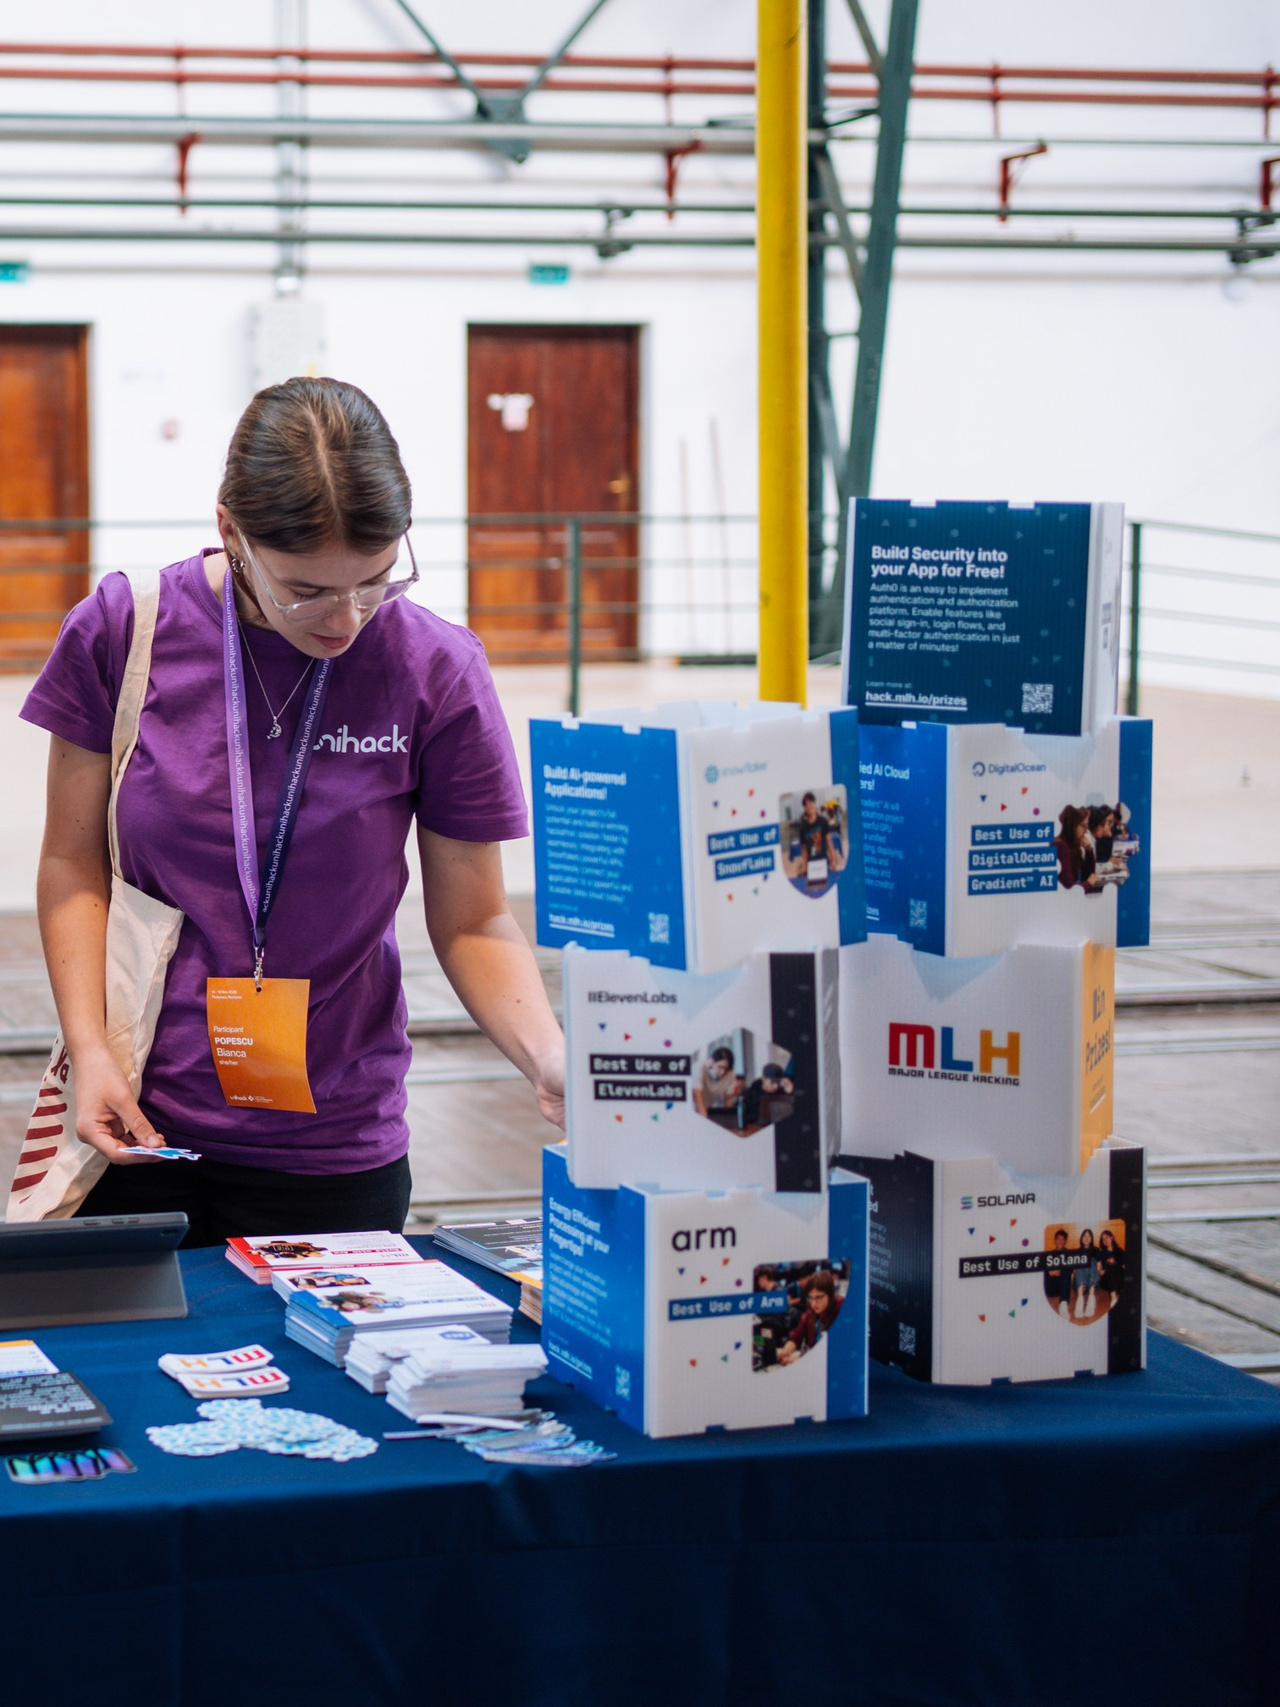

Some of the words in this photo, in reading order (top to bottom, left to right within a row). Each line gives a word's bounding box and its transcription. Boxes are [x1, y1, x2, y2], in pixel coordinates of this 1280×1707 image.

[871, 545, 909, 560] Build
[912, 547, 975, 563] Security
[977, 549, 1008, 562] into
[871, 563, 905, 578] your
[907, 563, 939, 579] App
[941, 564, 963, 578] for
[965, 564, 1005, 579] Free!
[899, 583, 908, 593] is
[909, 585, 921, 594] an
[923, 586, 946, 596] easy
[947, 585, 957, 595] to
[958, 585, 1009, 597] implement
[869, 594, 936, 606] authentication
[936, 596, 955, 606] and
[956, 597, 1019, 608] authorization
[868, 605, 910, 617] platform.
[911, 607, 943, 618] Enable
[945, 608, 984, 619] features
[985, 610, 1002, 620] like
[868, 617, 895, 627] social
[896, 617, 932, 630] sign-in,
[932, 619, 956, 631] login
[957, 620, 985, 631] flows,
[987, 621, 1006, 631] and
[867, 628, 922, 640] multi-factor
[923, 630, 991, 643] authentication
[992, 633, 1001, 642] in
[1002, 634, 1020, 645] just
[875, 641, 905, 651] matter
[907, 642, 918, 651] of
[919, 643, 960, 652] minutes!
[866, 680, 884, 688] Learn
[865, 690, 968, 706] hack.mlh.io/prizes
[543, 765, 567, 780] Build
[873, 763, 883, 776] AI
[884, 765, 910, 780] Cloud
[988, 762, 1046, 775] DigitalOcean
[544, 781, 608, 801] Applications!
[709, 836, 736, 851] Best
[739, 832, 760, 846] Use
[763, 828, 778, 843] of
[974, 829, 1003, 841] Best
[1009, 828, 1031, 840] Use
[1036, 826, 1051, 839] of
[717, 856, 773, 876] Snowflake
[972, 851, 1055, 868] DigitalOcean
[1039, 875, 1054, 888] AI
[213, 1025, 244, 1034] Participant
[214, 1036, 254, 1046] POPESCU
[888, 1022, 1020, 1076] MLH
[216, 1047, 247, 1058] Bianca
[593, 1057, 628, 1072] Best
[634, 1057, 662, 1072] Use
[668, 1057, 687, 1072] of
[888, 1067, 925, 1079] MAJOR
[928, 1070, 969, 1082] LEAGUE
[972, 1074, 1020, 1087] HACKING
[597, 1082, 684, 1098] ElevenLabs
[976, 1193, 1036, 1209] SOLANA
[671, 1226, 737, 1252] arm
[962, 1260, 991, 1274] Best
[997, 1258, 1019, 1271] Use
[1025, 1256, 1040, 1269] of
[1045, 1253, 1088, 1267] Solana
[671, 1301, 704, 1317] Best
[709, 1298, 732, 1313] Use
[739, 1296, 754, 1311] of
[761, 1293, 784, 1309] Arm
[179, 1350, 267, 1369] MLH
[193, 1371, 282, 1390] MLH
